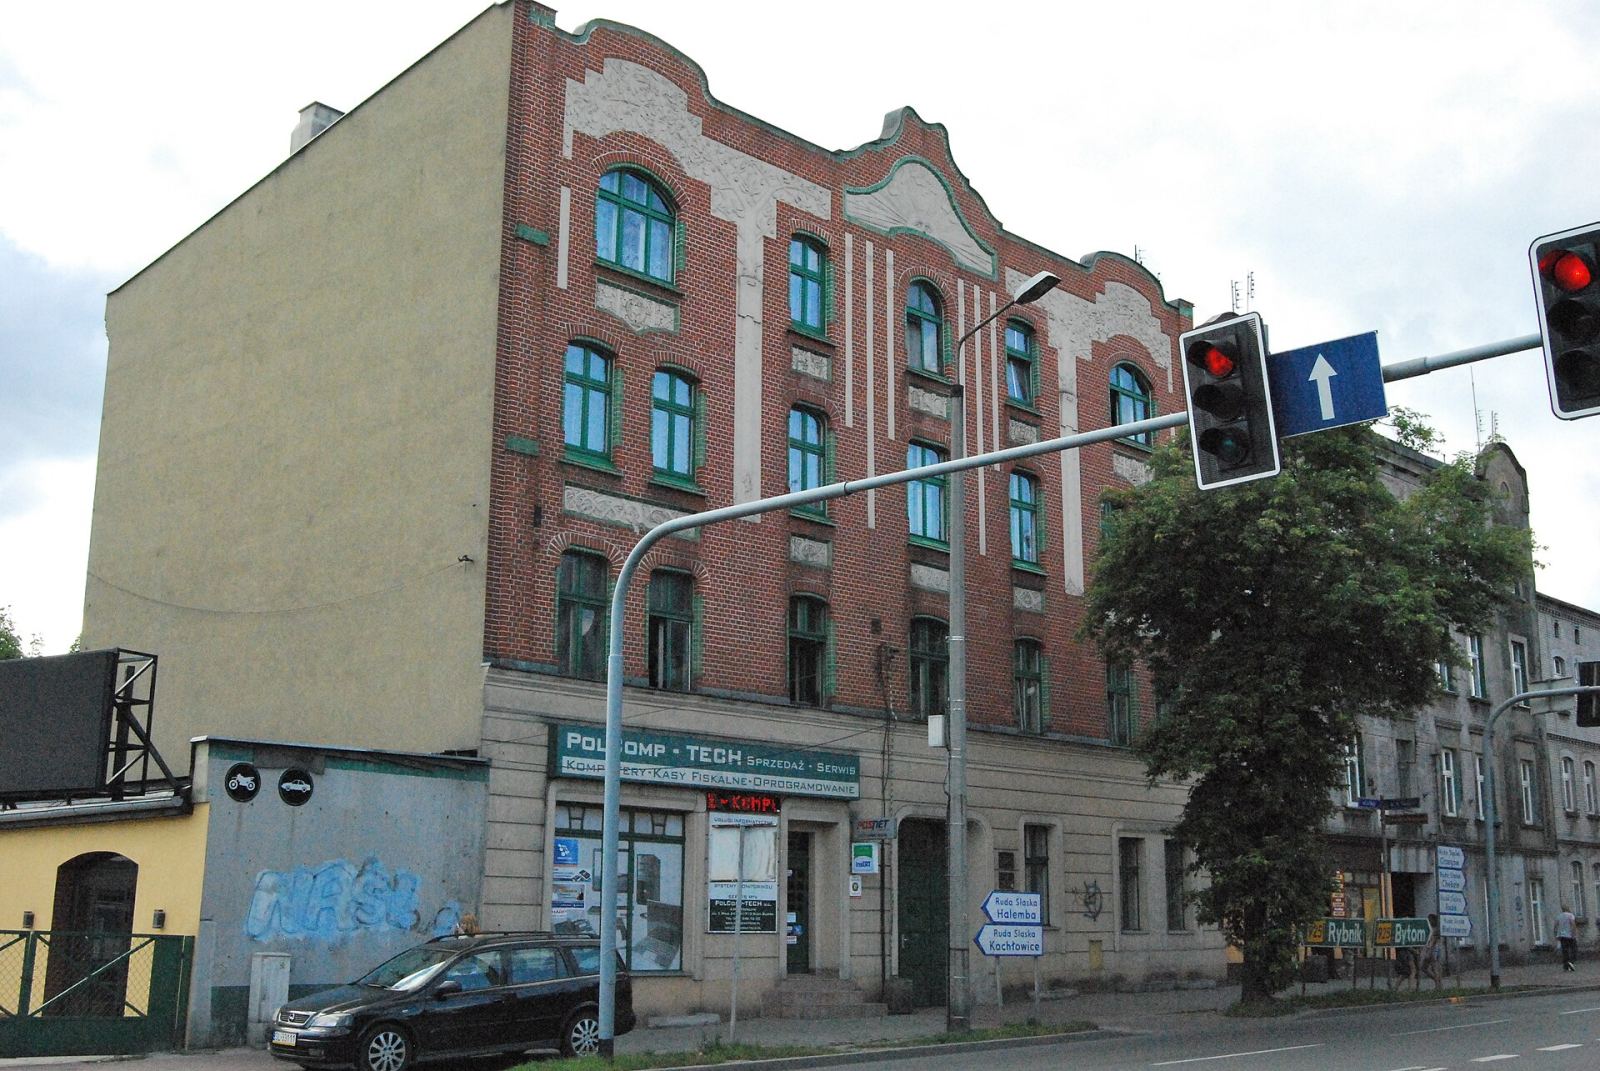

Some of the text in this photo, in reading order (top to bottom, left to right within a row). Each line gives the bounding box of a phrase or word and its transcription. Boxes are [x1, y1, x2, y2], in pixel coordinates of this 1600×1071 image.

[566, 732, 856, 775] POLOMP TECH SPRZEDAŻ SERWIS
[566, 759, 856, 794] KOMPERY KASY FISKALNE OPROGRAMOWANIE
[995, 897, 1013, 906] Ruda
[997, 909, 1036, 920] Halemba
[993, 928, 1012, 938] Ruda
[1328, 921, 1363, 945] Rybnik
[1394, 923, 1426, 945] Bytom
